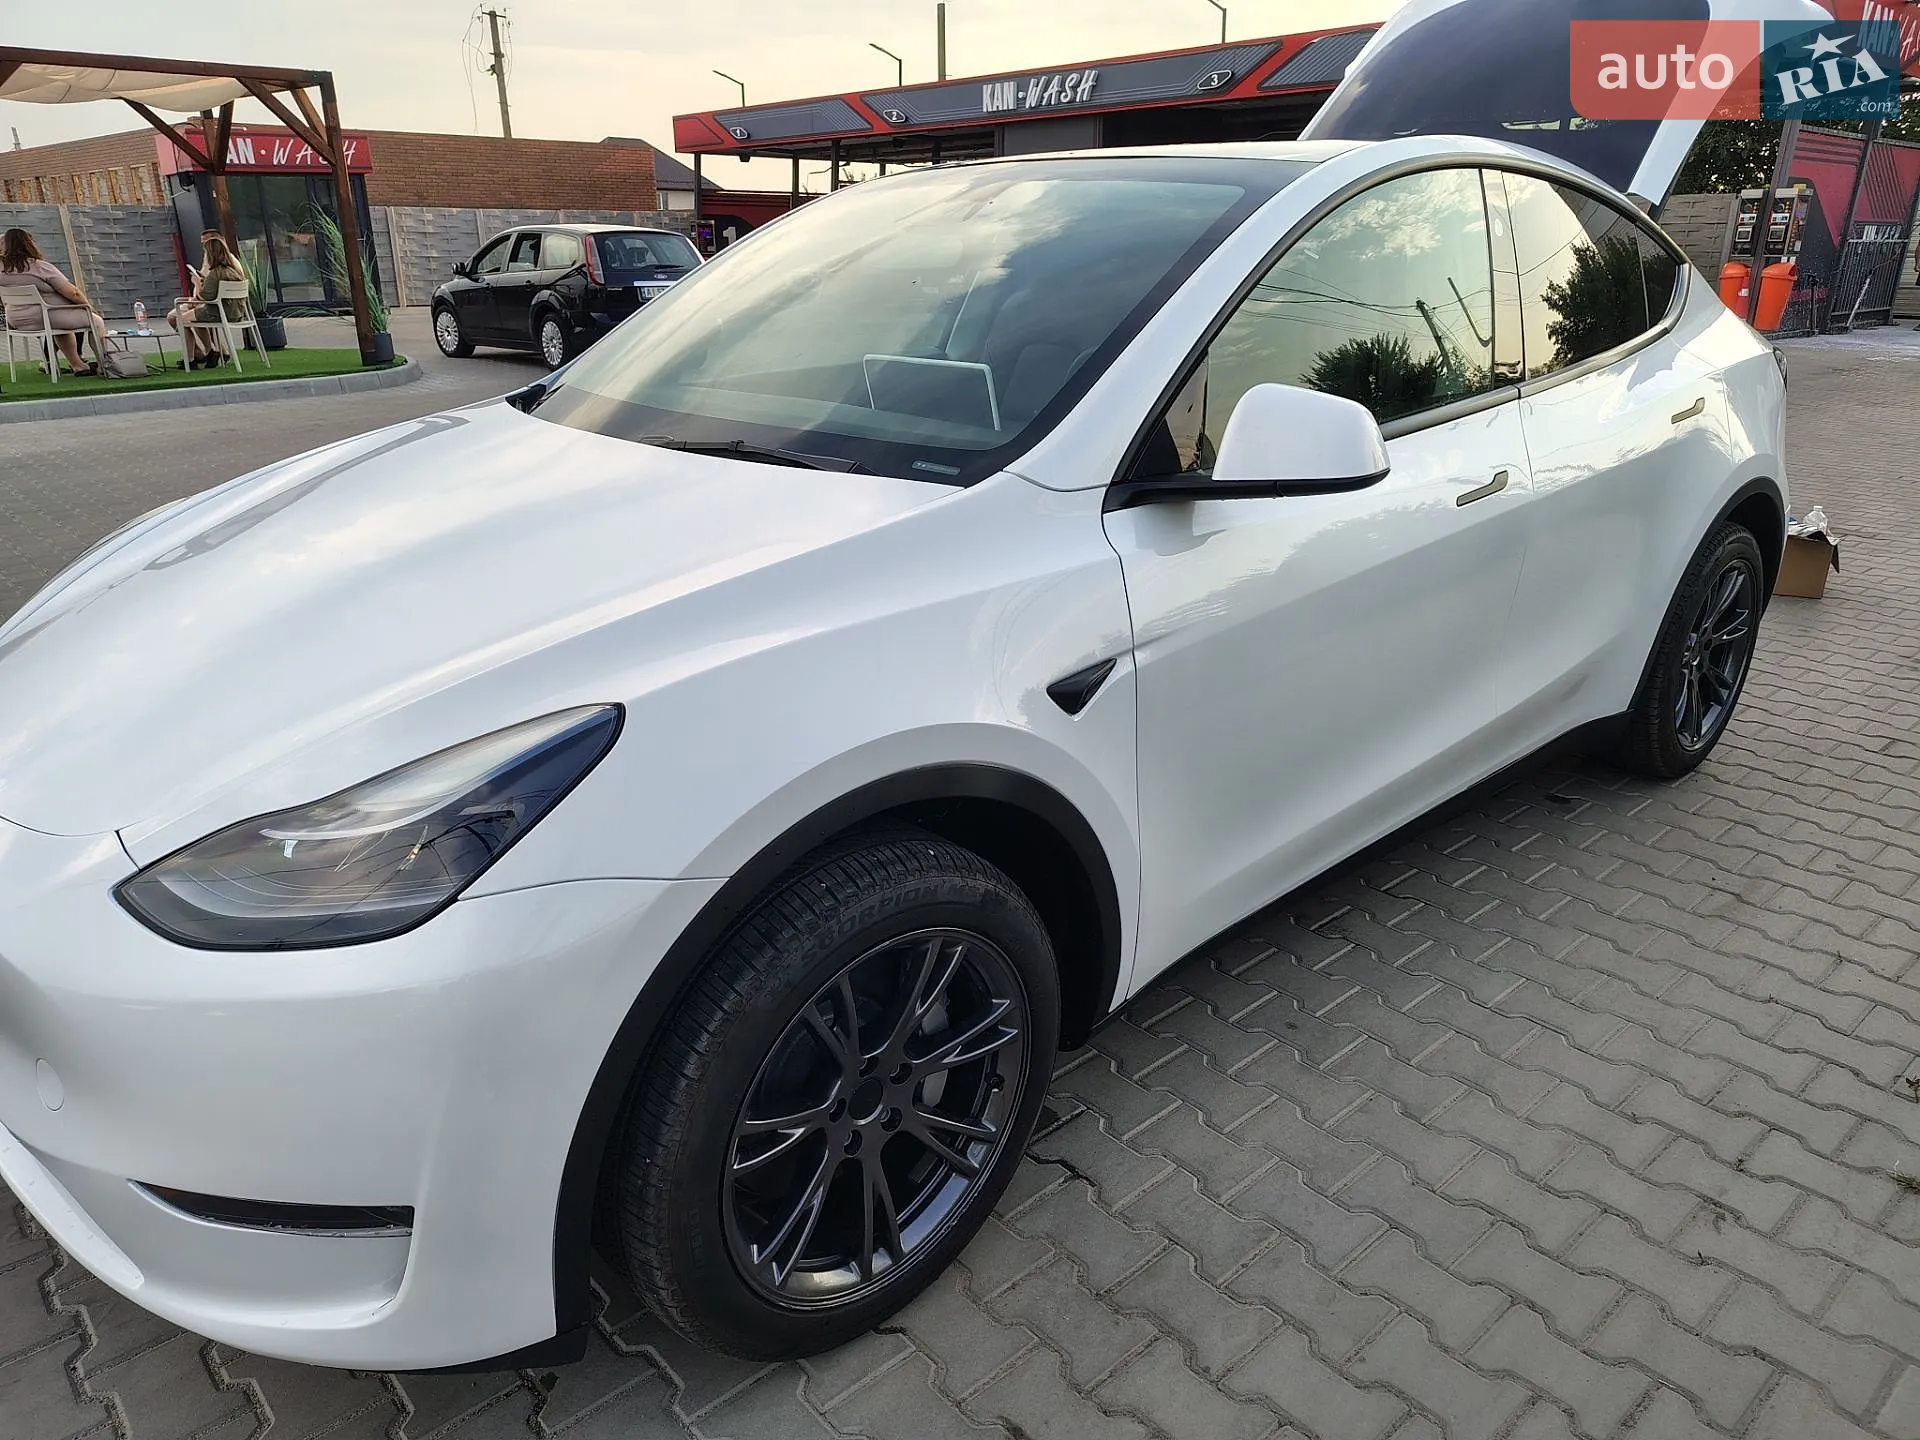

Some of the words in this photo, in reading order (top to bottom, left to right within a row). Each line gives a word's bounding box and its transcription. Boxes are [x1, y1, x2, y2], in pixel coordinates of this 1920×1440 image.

[982, 81, 1017, 112] KAN
[1025, 70, 1098, 109] WASH
[1210, 74, 1218, 86] 3
[225, 138, 256, 165] AN
[272, 138, 357, 165] WAH
[722, 226, 737, 246] 1
